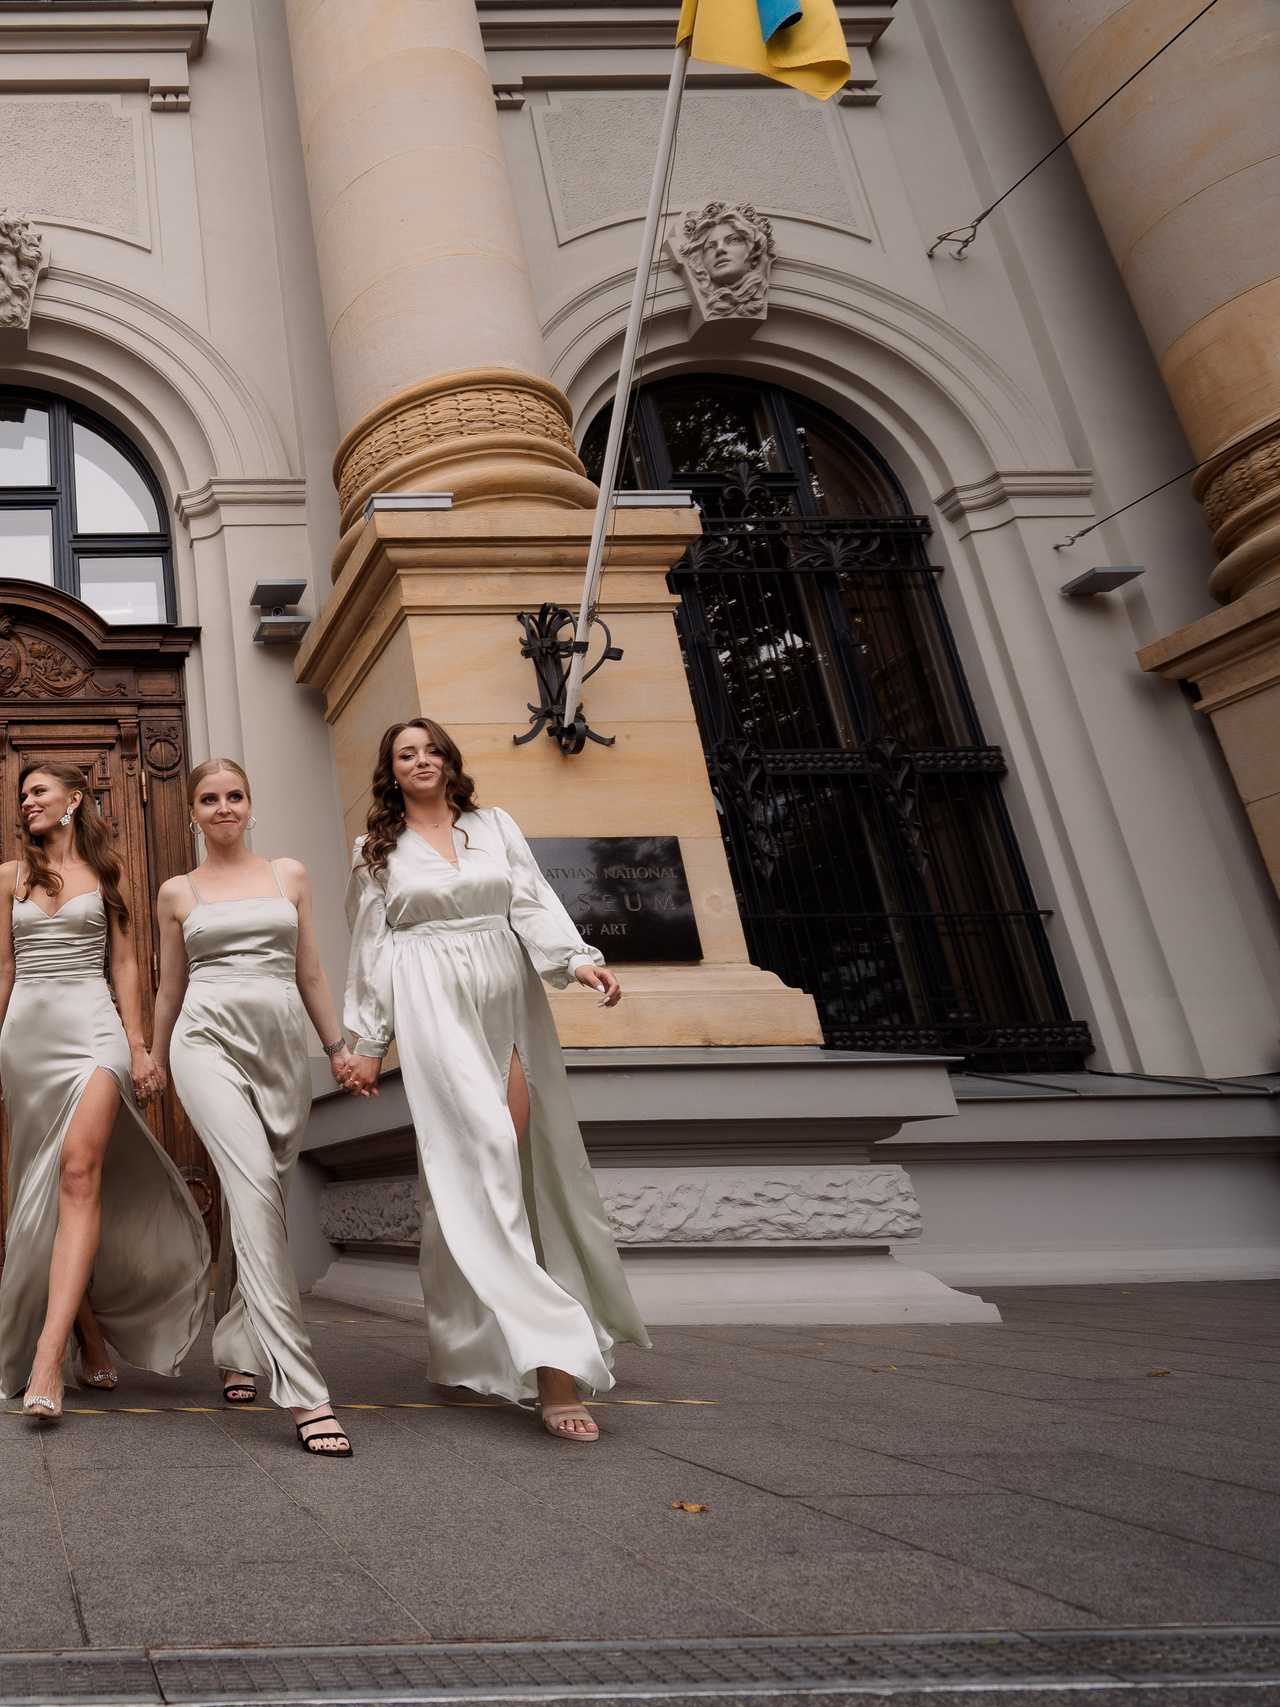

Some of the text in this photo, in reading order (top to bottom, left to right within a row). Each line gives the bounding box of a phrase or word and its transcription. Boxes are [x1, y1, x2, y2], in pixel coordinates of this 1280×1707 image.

[604, 867, 679, 879] NATIONAL
[561, 893, 677, 912] SEUM
[575, 923, 627, 936] OF ART
